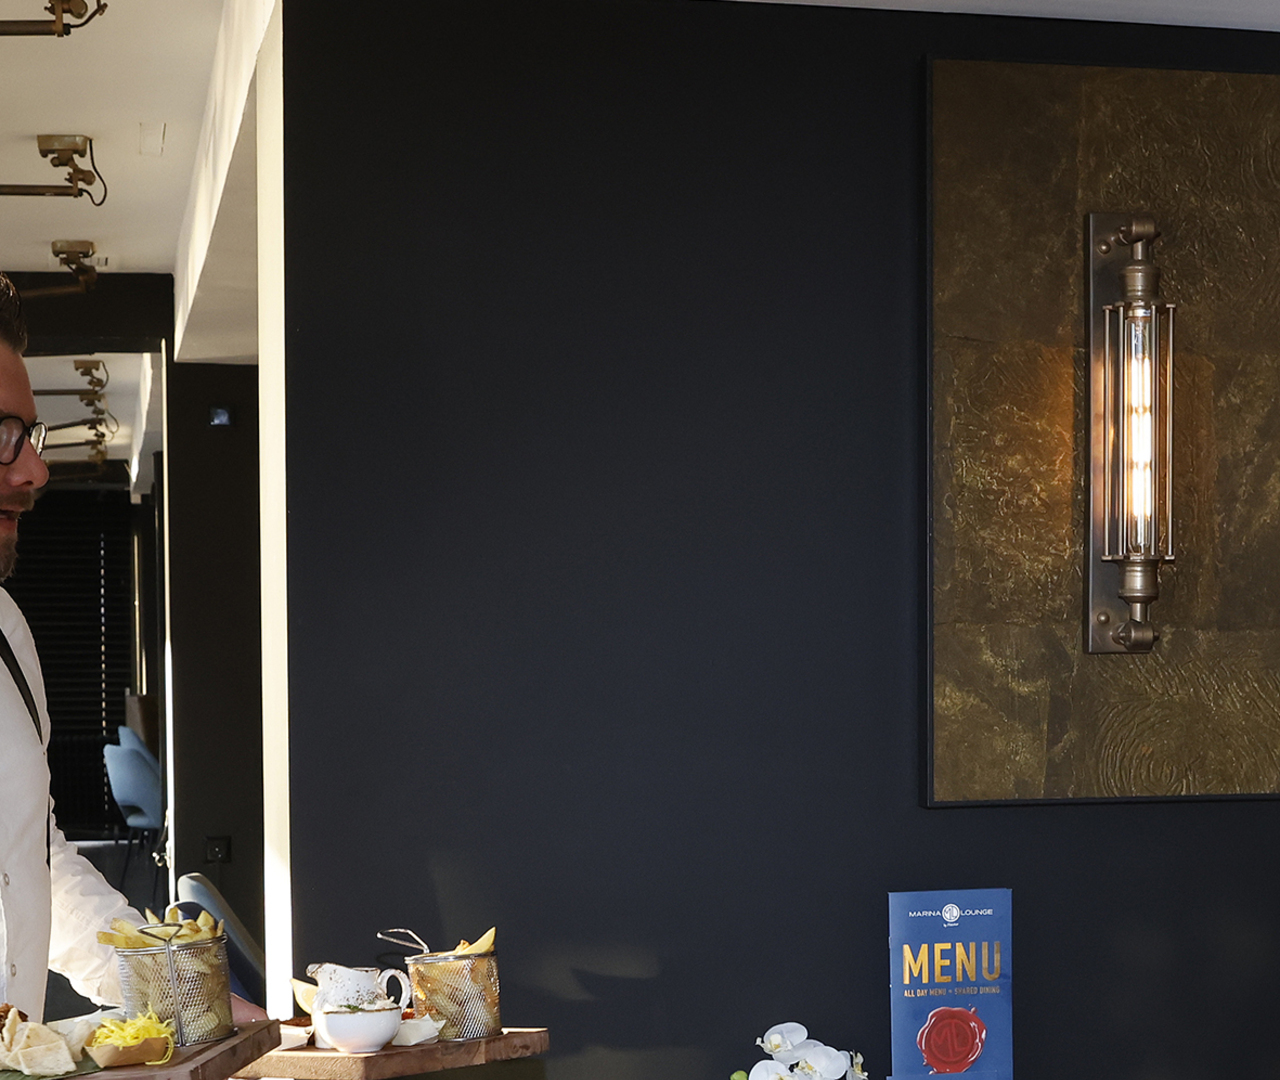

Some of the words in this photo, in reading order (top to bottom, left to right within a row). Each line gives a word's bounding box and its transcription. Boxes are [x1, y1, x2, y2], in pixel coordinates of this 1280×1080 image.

[908, 910, 941, 918] MARINA
[960, 908, 993, 916] LOUNGE
[903, 941, 1001, 985] MENU
[904, 989, 915, 997] ALL
[916, 989, 928, 997] DAY
[929, 988, 946, 996] MENU
